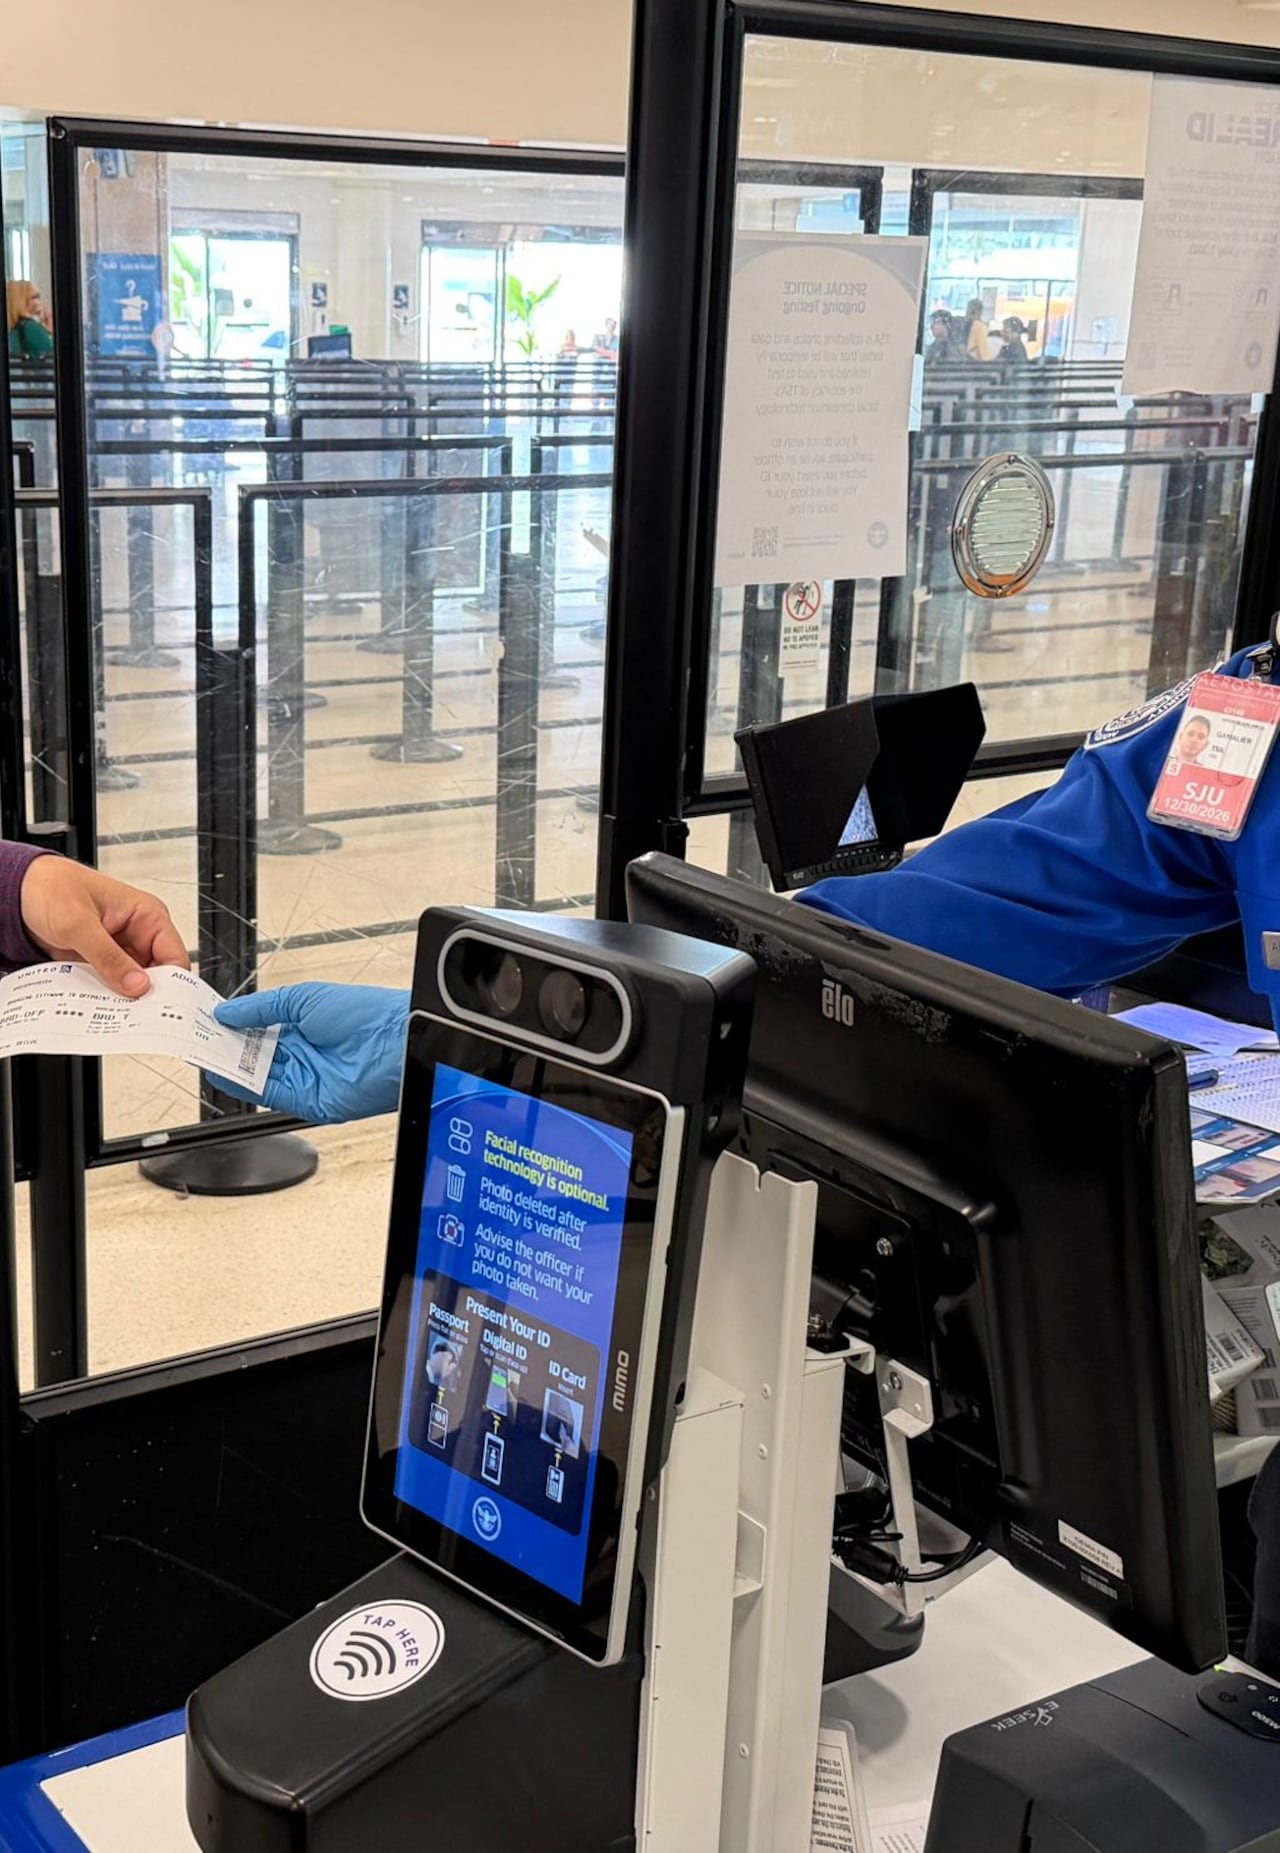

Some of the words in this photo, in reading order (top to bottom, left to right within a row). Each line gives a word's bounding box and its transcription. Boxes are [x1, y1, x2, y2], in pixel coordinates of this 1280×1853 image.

[1199, 674, 1280, 698] AEROSTA
[1164, 797, 1231, 822] 12/30/2026
[1182, 782, 1225, 806] SJU
[483, 1149, 544, 1187] technology
[546, 1175, 556, 1190] is
[557, 1180, 609, 1212] optional.
[485, 1130, 517, 1154] Facial
[518, 1145, 583, 1182] recognition
[479, 1195, 521, 1227] identity
[523, 1212, 533, 1230] is
[534, 1219, 582, 1251] verified.
[481, 1177, 513, 1202] Photo
[514, 1191, 557, 1220] deleted
[557, 1210, 588, 1233] after
[474, 1242, 495, 1260] you
[497, 1250, 511, 1269] do
[513, 1261, 532, 1280] not
[534, 1268, 563, 1293] want
[565, 1282, 594, 1305] your
[475, 1223, 514, 1252] Advise
[514, 1238, 534, 1261] the
[535, 1250, 573, 1277] officer
[575, 1264, 585, 1283] if
[472, 1260, 504, 1285] photo
[505, 1273, 539, 1301] taken.
[428, 1301, 470, 1334] Passport
[466, 1295, 510, 1329] Present
[509, 1315, 536, 1342] Your
[537, 1329, 551, 1349] ID
[483, 1328, 515, 1356] Digital
[514, 1344, 528, 1361] ID
[549, 1359, 560, 1377] ID
[562, 1368, 587, 1390] Card
[613, 1350, 630, 1412] mimo
[363, 1614, 396, 1629] TAP
[395, 1628, 419, 1668] HERE
